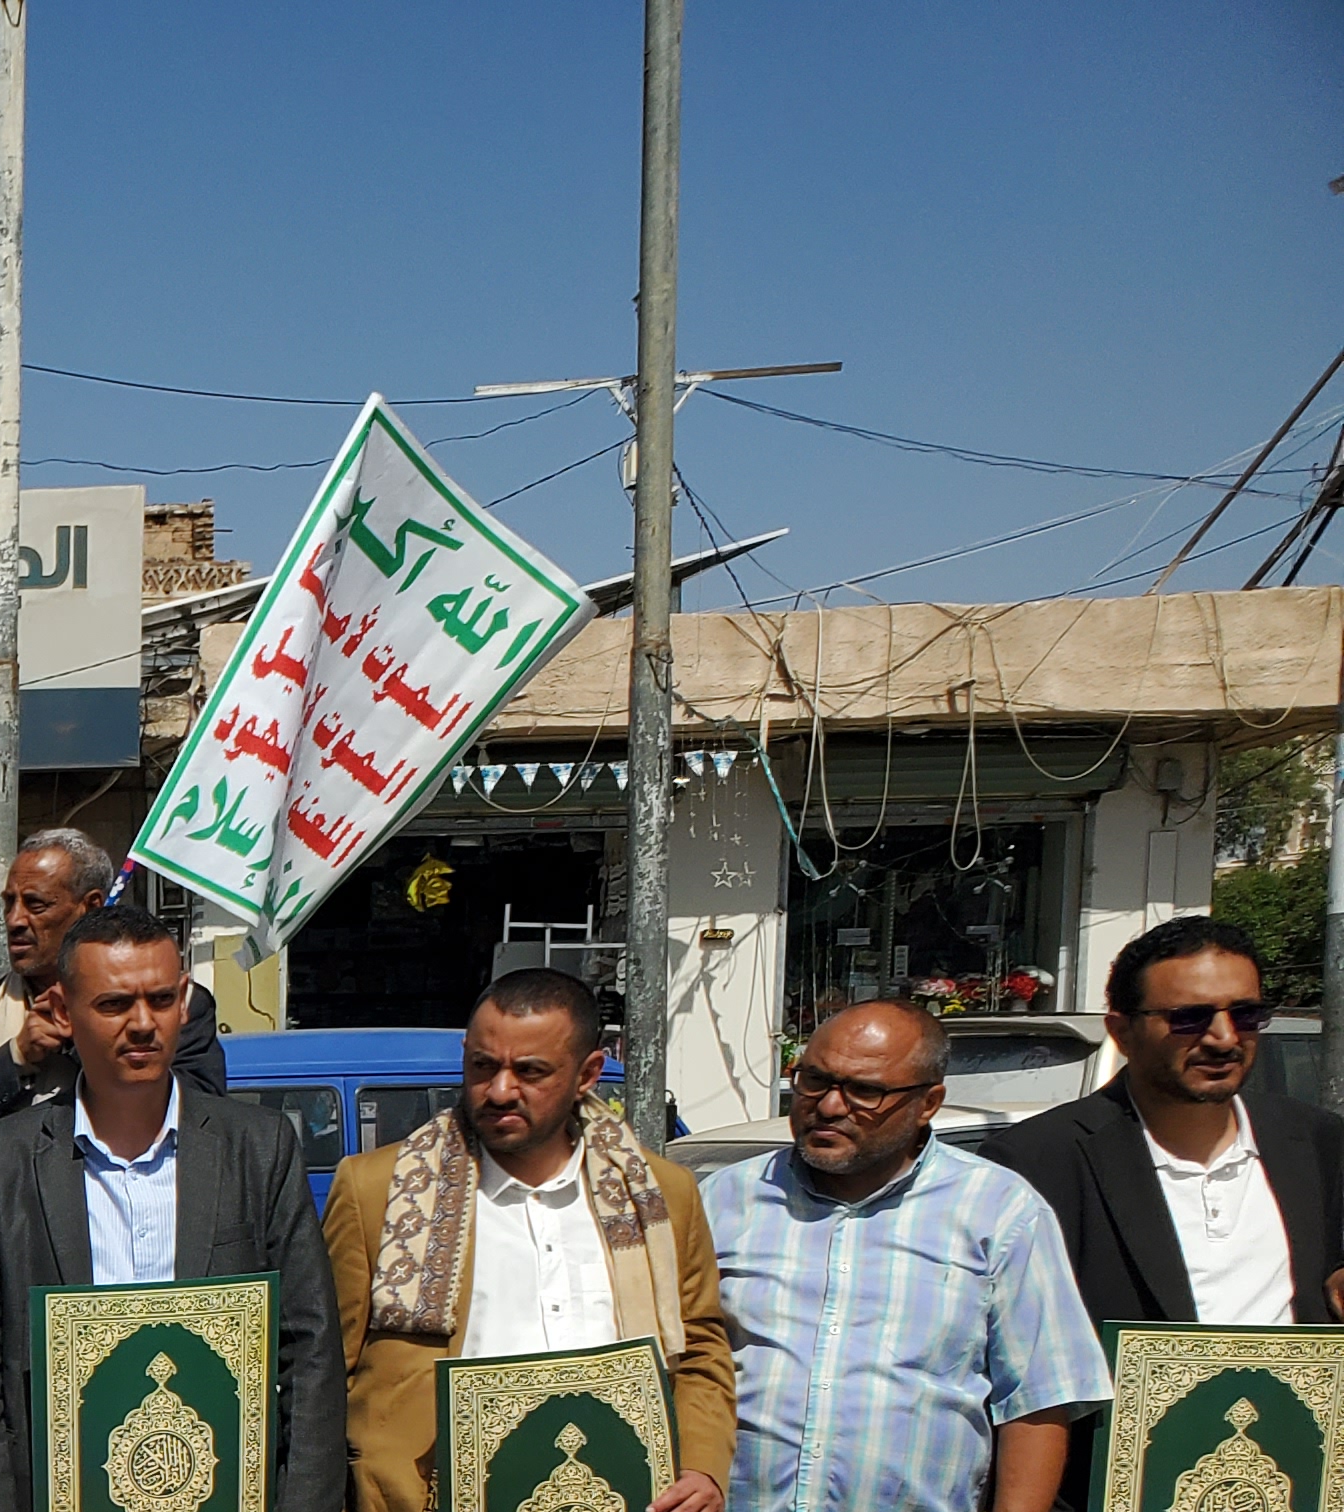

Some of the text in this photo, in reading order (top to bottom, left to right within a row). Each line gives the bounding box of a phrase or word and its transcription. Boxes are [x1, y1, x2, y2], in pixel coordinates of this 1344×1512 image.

[426, 574, 544, 671] الله
[362, 644, 473, 741] الموت
[313, 711, 419, 804] الموت
[288, 779, 367, 869] اللعنة
